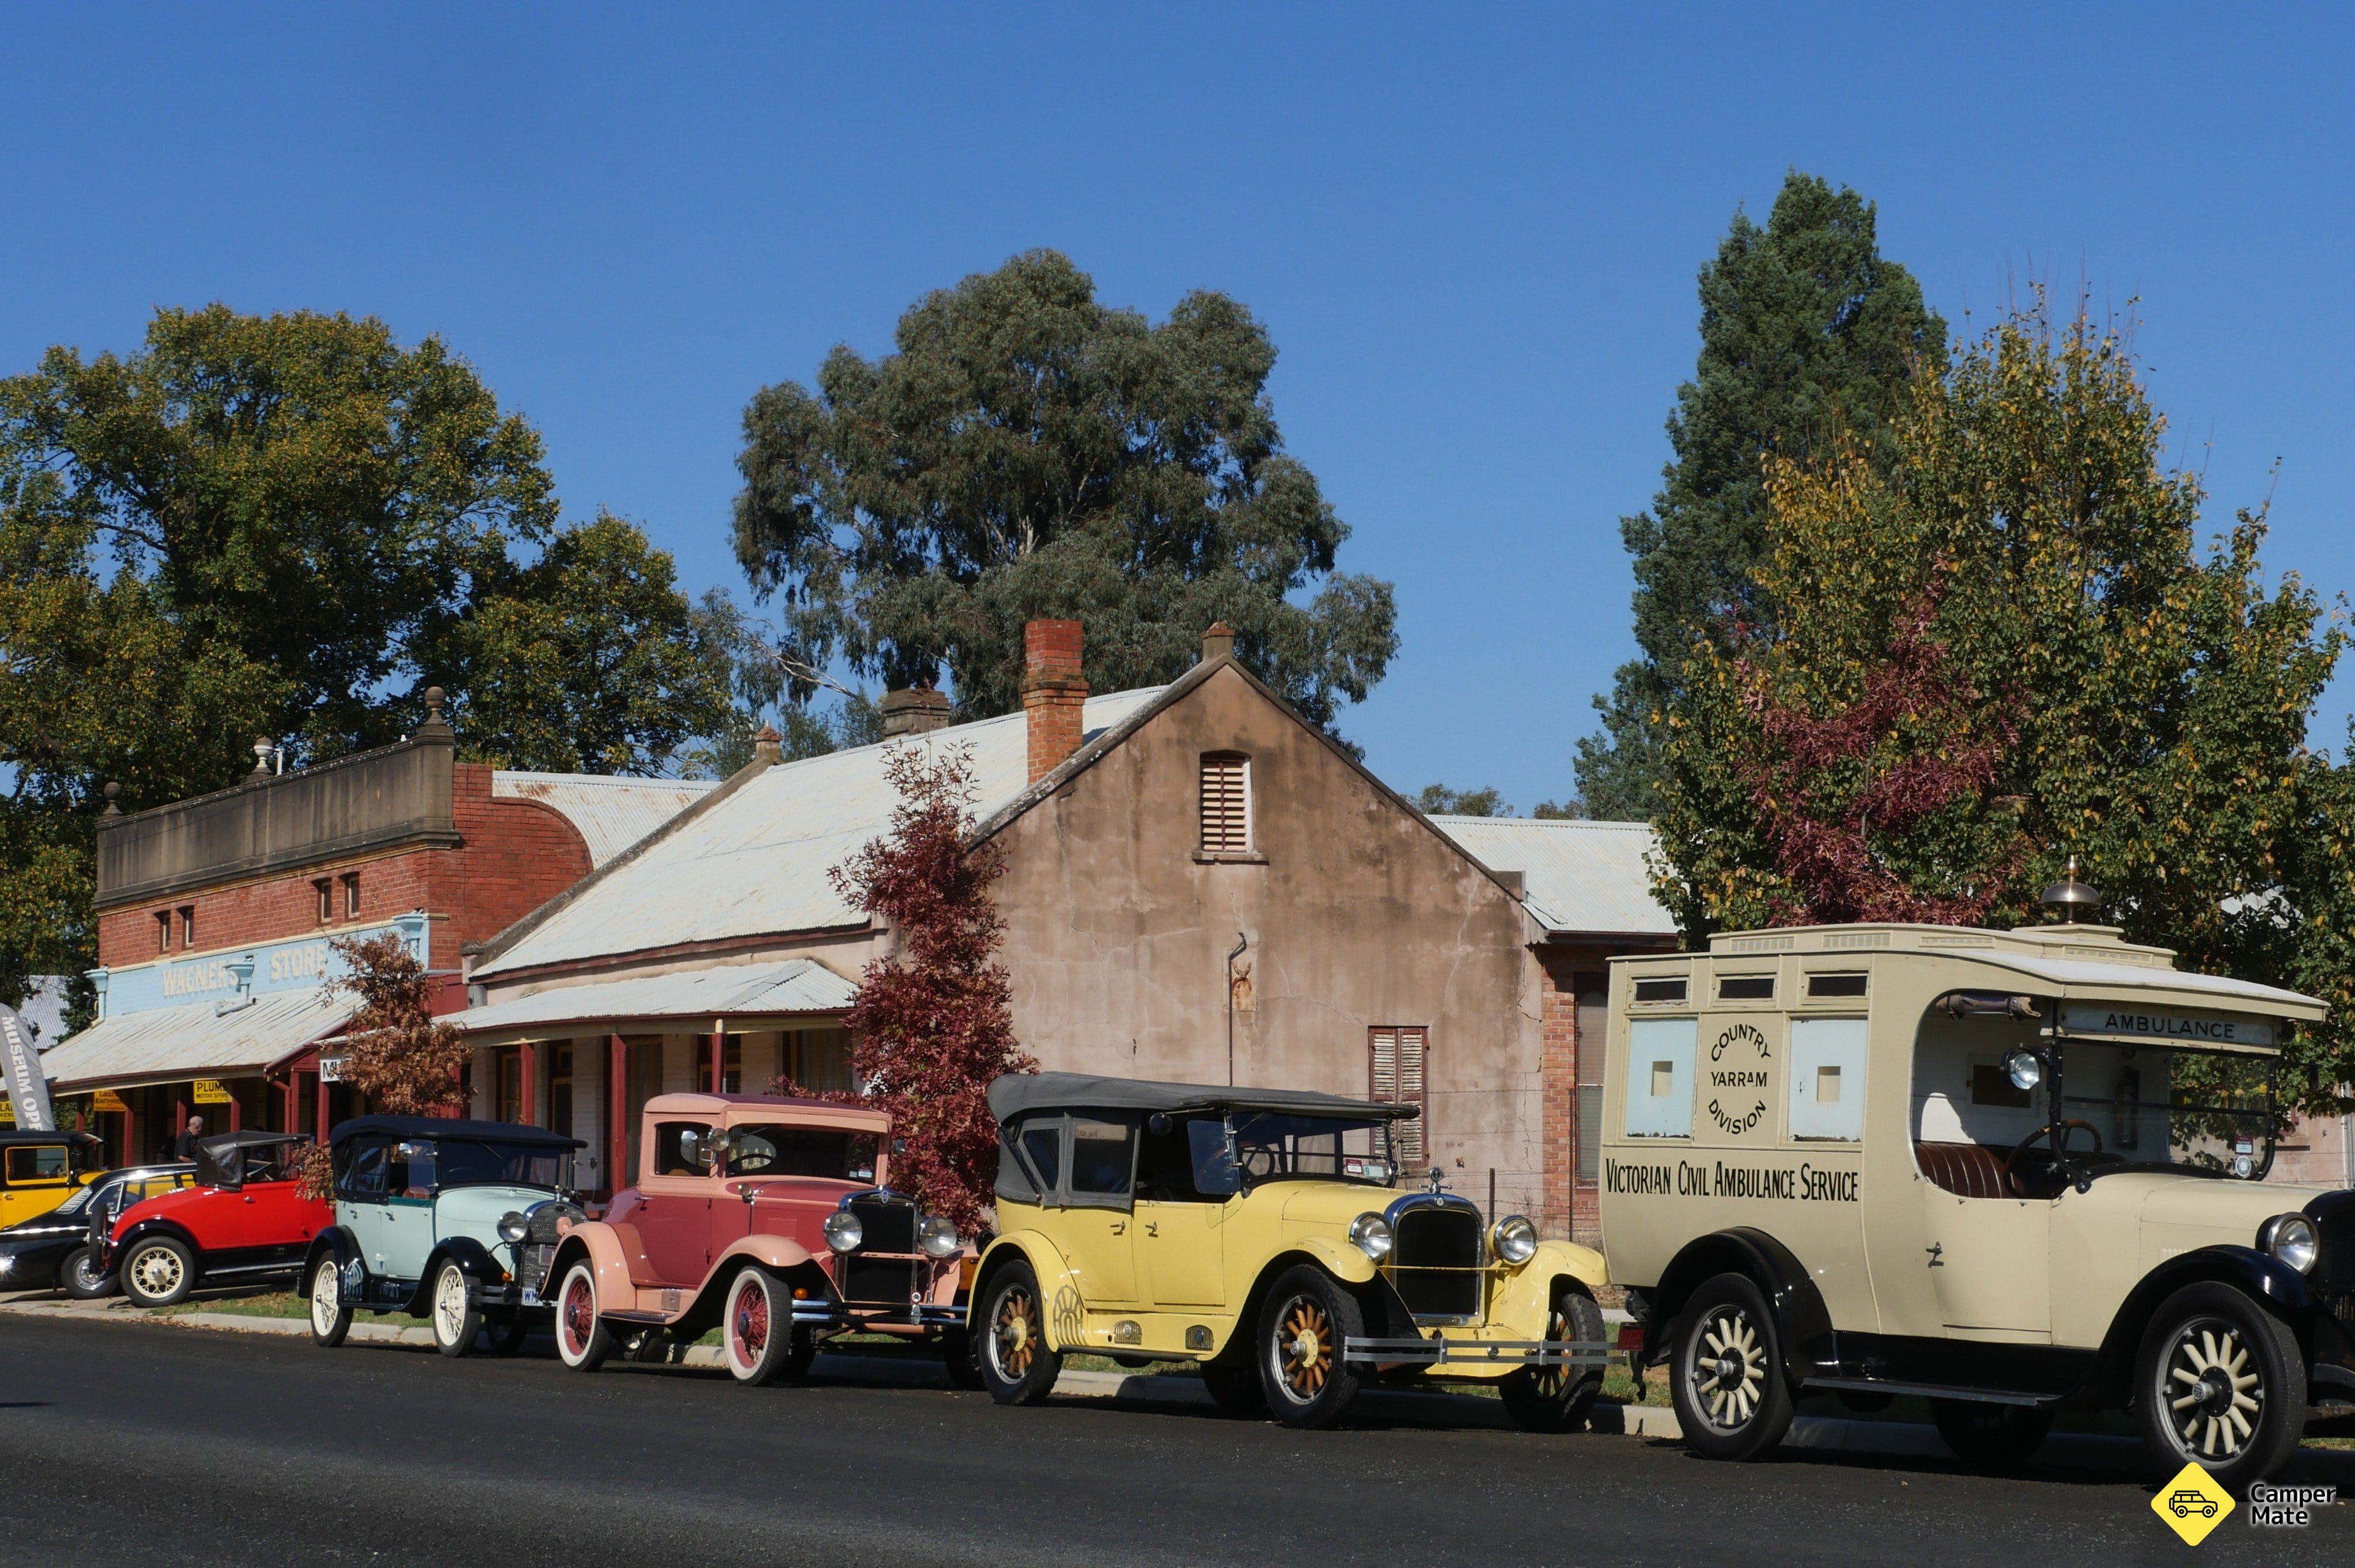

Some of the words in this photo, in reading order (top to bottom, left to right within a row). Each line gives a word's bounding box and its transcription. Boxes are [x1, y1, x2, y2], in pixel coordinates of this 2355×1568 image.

[270, 943, 327, 981] STORE
[1711, 1024, 1772, 1062] COUNTRY
[2105, 1013, 2235, 1039] AMBULANCE
[2, 1016, 34, 1094] MUSEUM
[1710, 1071, 1767, 1087] YARRAM
[1708, 1098, 1766, 1135] DIVISION
[1606, 1158, 1671, 1195] VICTORIAN
[1677, 1160, 1710, 1197] CIVIL
[1714, 1161, 1796, 1200] AMBULANCE
[1800, 1162, 1859, 1202] SERVICE
